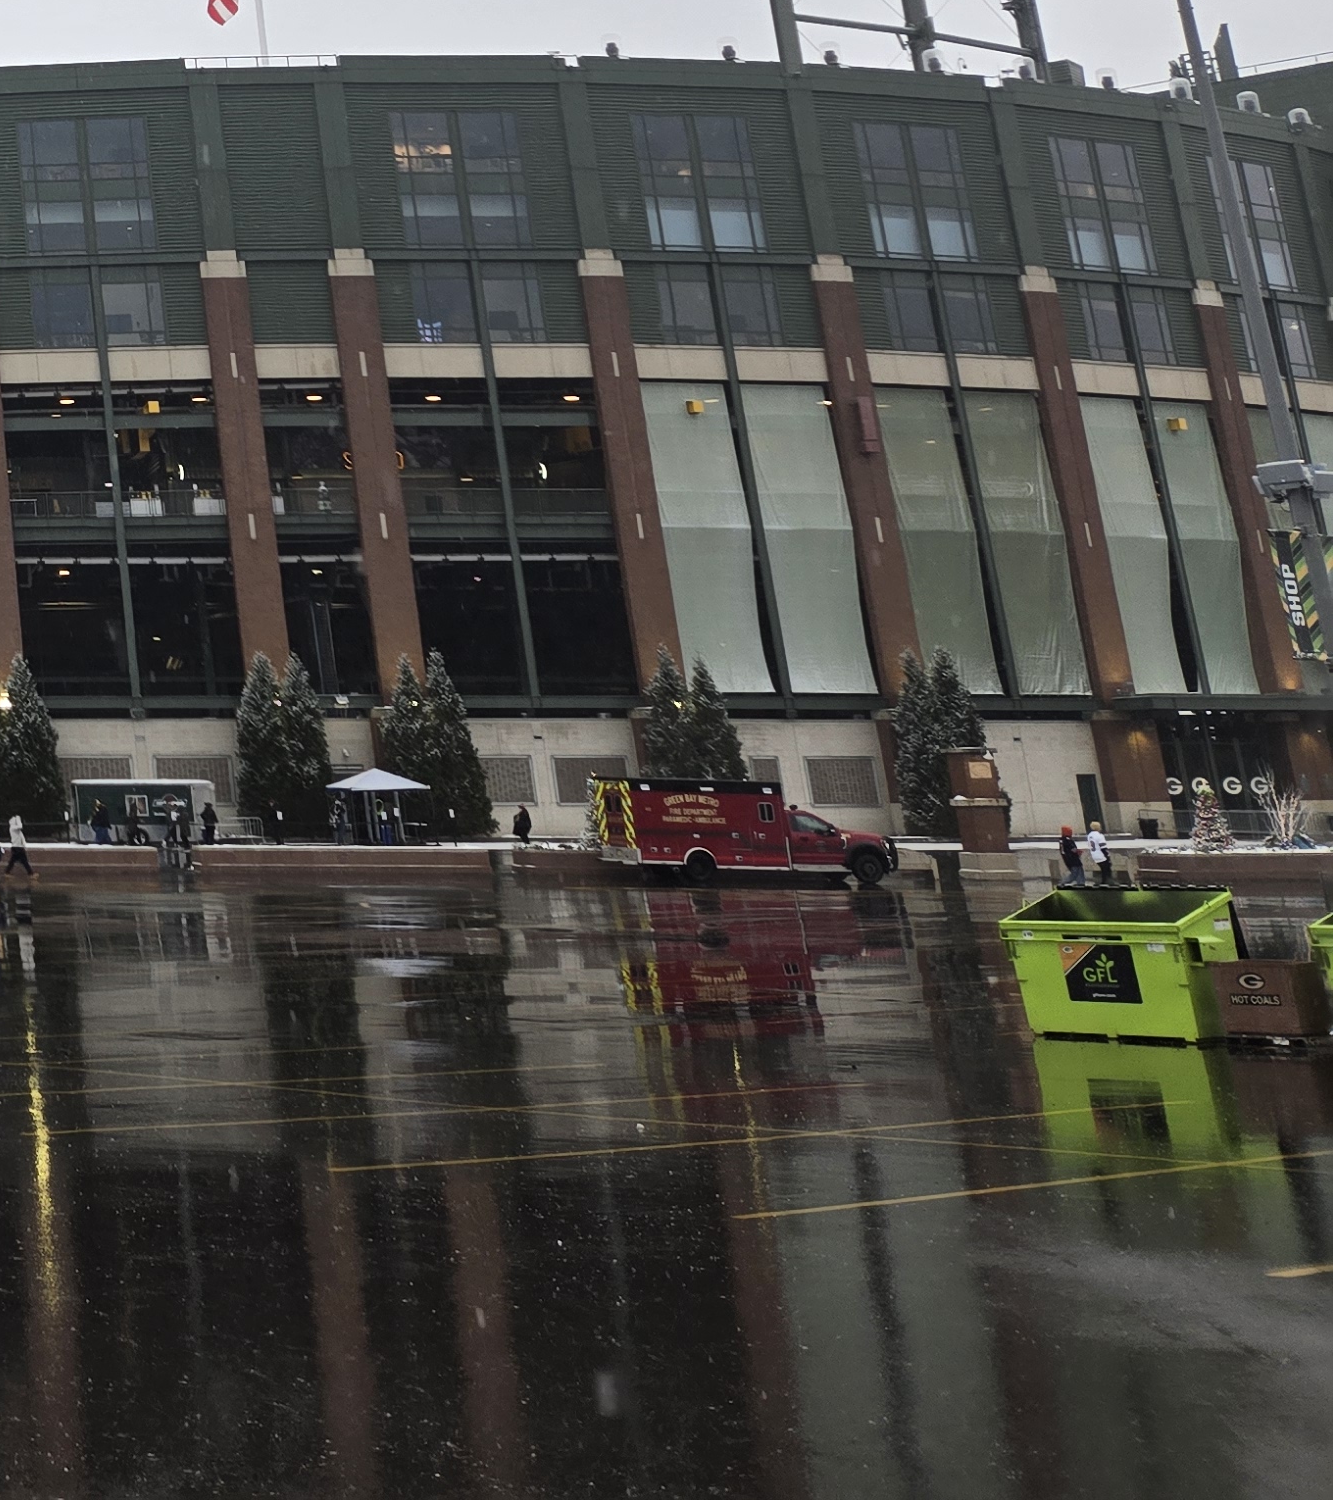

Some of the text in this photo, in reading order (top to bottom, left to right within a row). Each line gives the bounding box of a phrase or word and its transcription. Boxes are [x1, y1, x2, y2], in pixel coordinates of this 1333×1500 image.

[1281, 563, 1306, 627] SHOP
[1082, 960, 1118, 983] GFL
[1230, 995, 1280, 1005] HOT COALS
